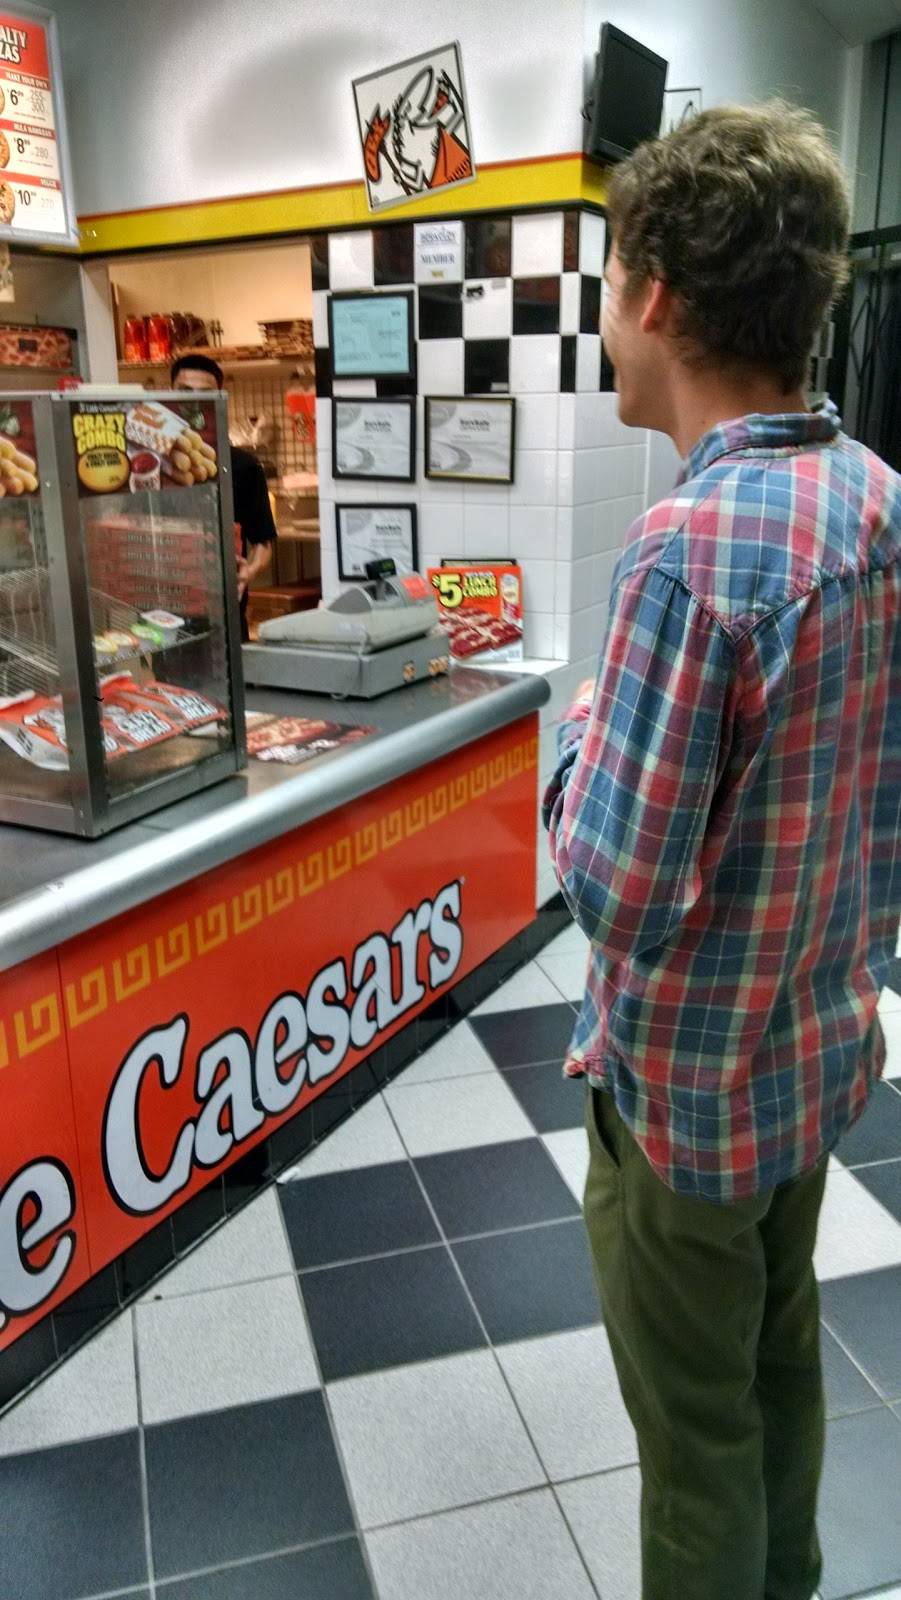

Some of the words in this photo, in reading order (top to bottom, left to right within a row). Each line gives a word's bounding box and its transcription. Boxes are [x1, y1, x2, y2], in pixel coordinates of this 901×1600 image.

[73, 413, 126, 438] CRAZY
[76, 430, 126, 455] COMBO
[431, 573, 462, 606] $5
[102, 880, 464, 1217] Caesars
